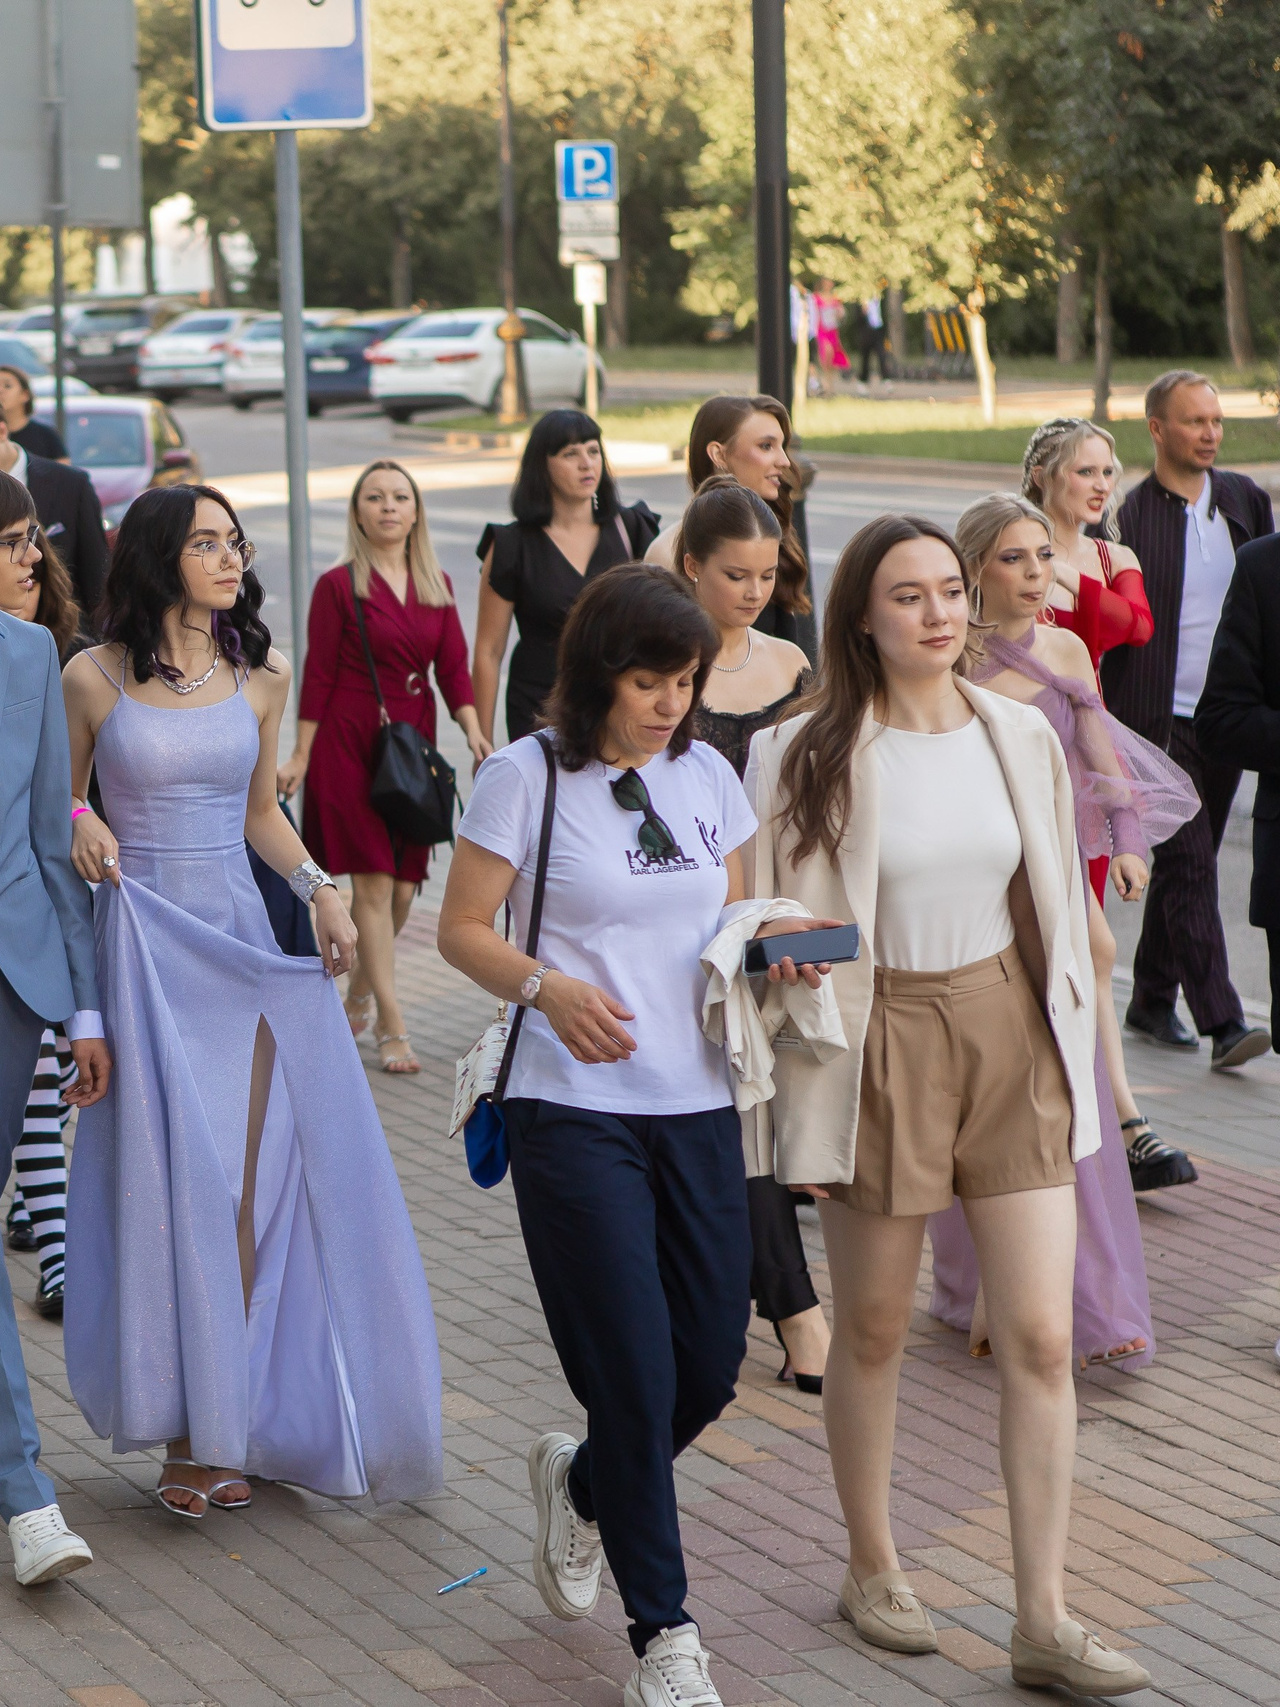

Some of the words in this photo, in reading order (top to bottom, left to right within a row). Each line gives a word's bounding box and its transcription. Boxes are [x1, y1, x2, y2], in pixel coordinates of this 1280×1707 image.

[573, 149, 607, 196] P
[630, 867, 651, 876] KARL
[652, 862, 699, 874] LAGERFELD
